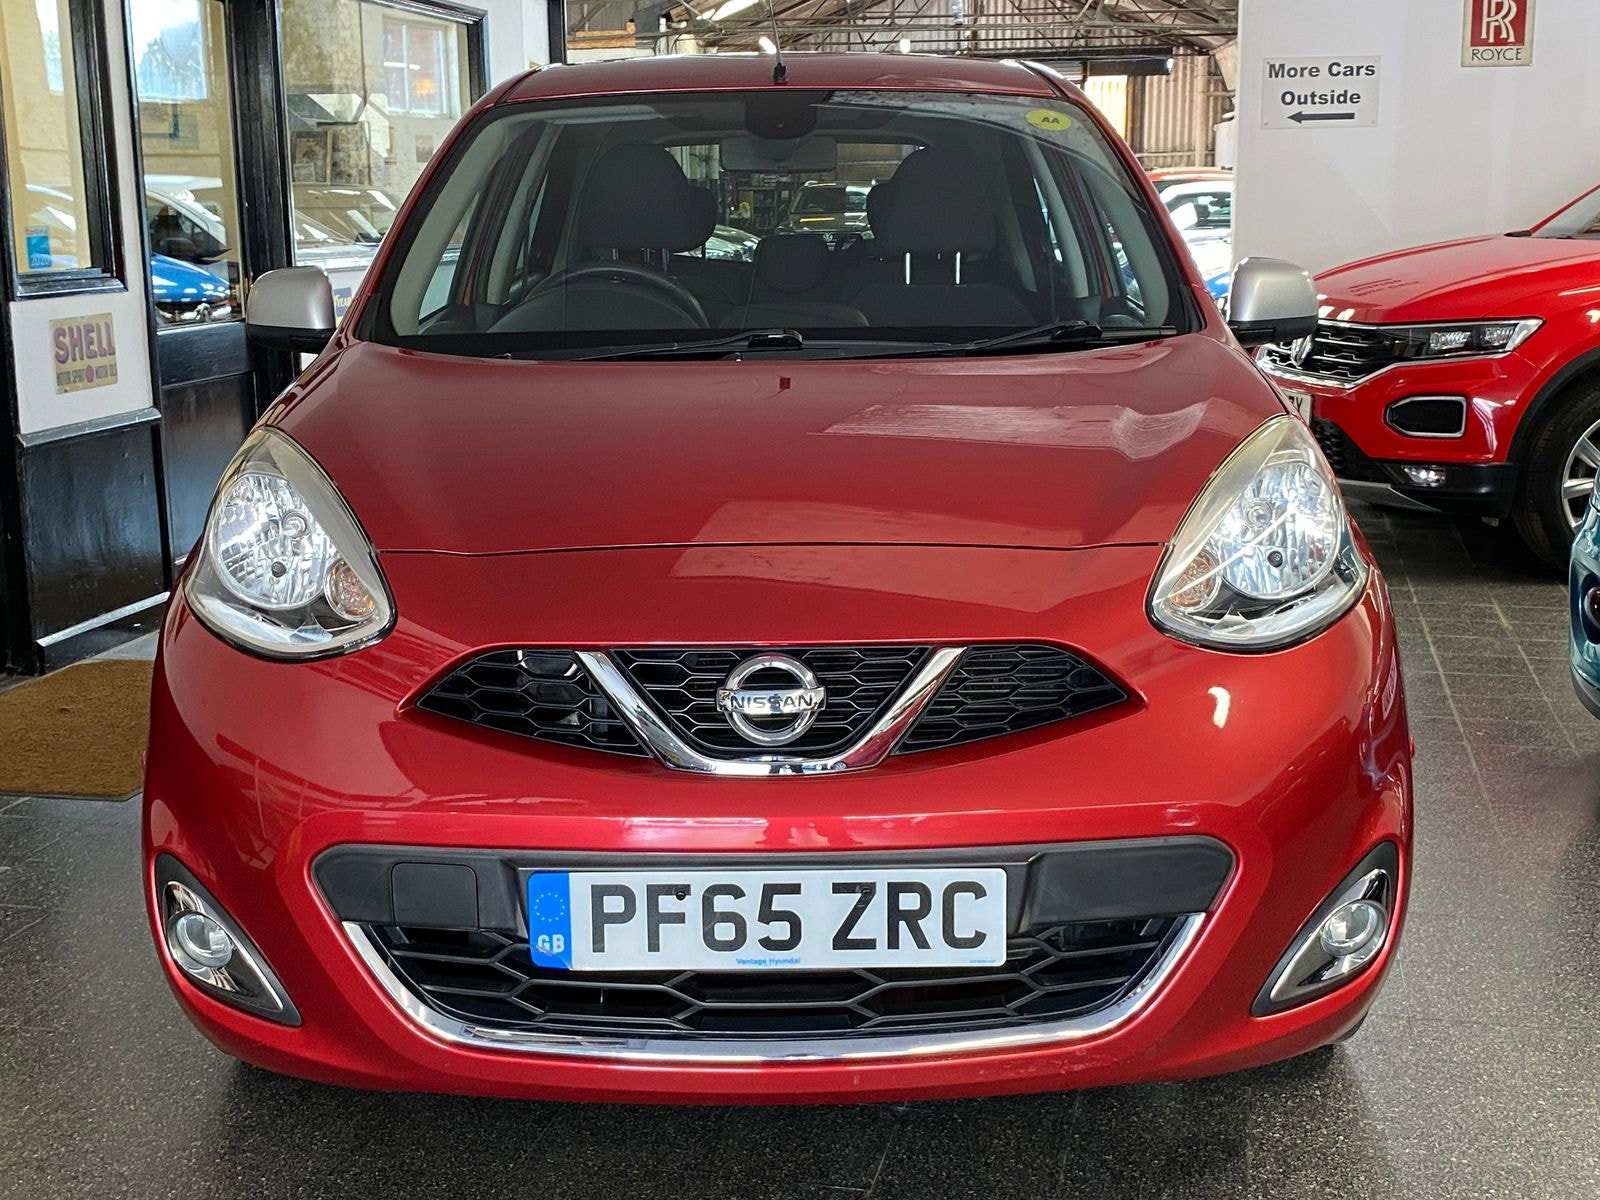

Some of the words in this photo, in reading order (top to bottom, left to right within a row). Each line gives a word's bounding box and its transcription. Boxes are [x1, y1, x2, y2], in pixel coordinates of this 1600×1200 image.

[1471, 47, 1523, 61] ROYCE
[1268, 63, 1320, 79] More
[1328, 61, 1376, 77] Cars
[1280, 89, 1361, 106] Outside
[1041, 116, 1060, 125] AA
[53, 321, 116, 365] SHELL
[730, 693, 813, 709] NISSAN
[590, 883, 802, 953] PF65
[832, 880, 987, 950] ZRC
[537, 933, 565, 954] GB
[736, 958, 767, 966] Vantage
[769, 957, 801, 966] Hyundai
